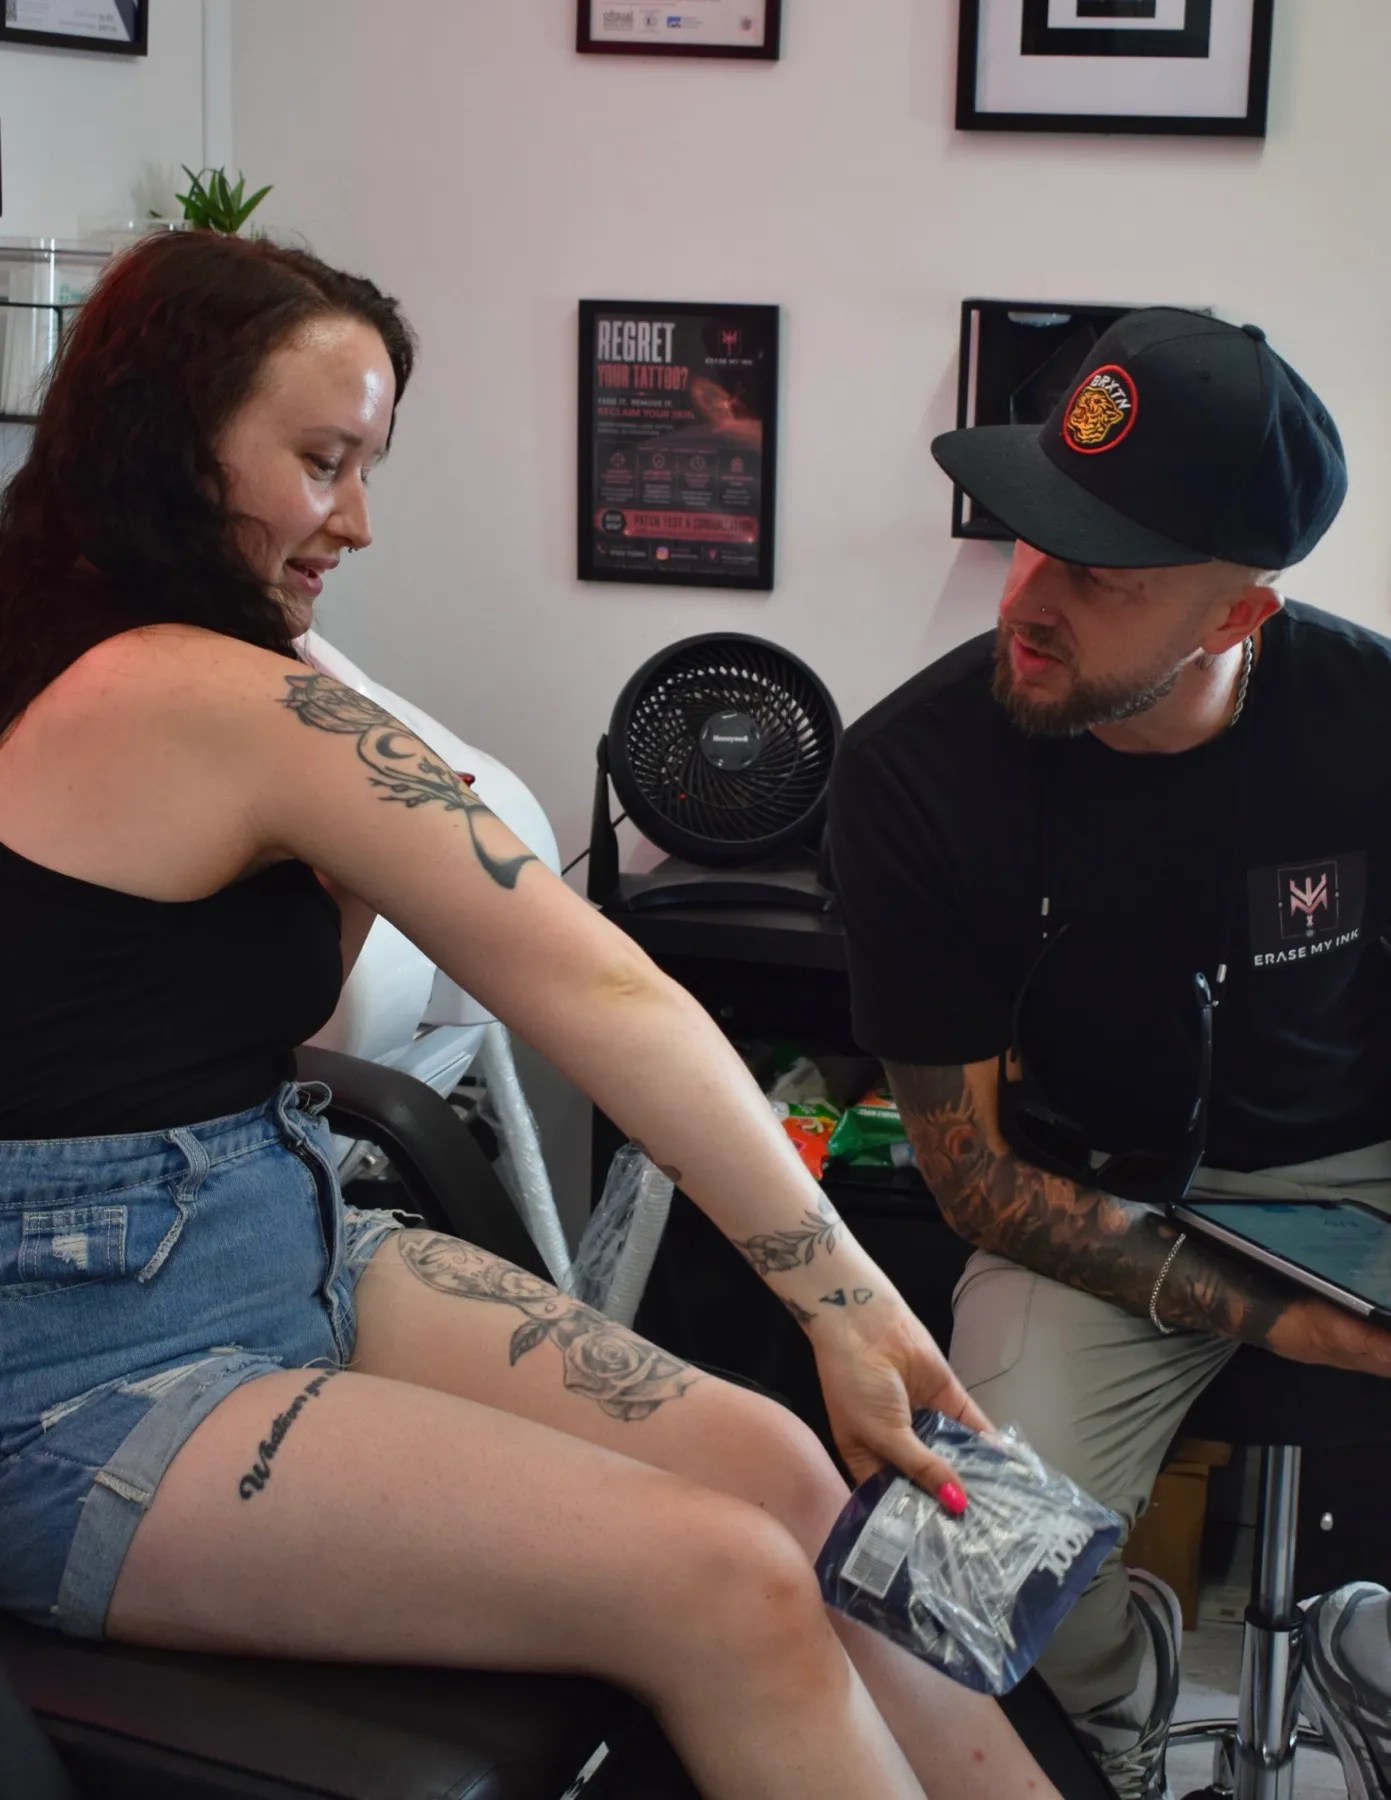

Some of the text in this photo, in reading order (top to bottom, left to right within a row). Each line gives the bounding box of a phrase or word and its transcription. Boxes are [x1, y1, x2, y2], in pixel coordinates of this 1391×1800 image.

[598, 320, 676, 363] REGRET
[598, 364, 688, 391] YOUR TATTOO?
[1090, 375, 1132, 409] BRXTN
[598, 407, 641, 417] RECLAIM
[643, 409, 670, 418] YOUR
[1254, 928, 1360, 966] ERASE MY INK
